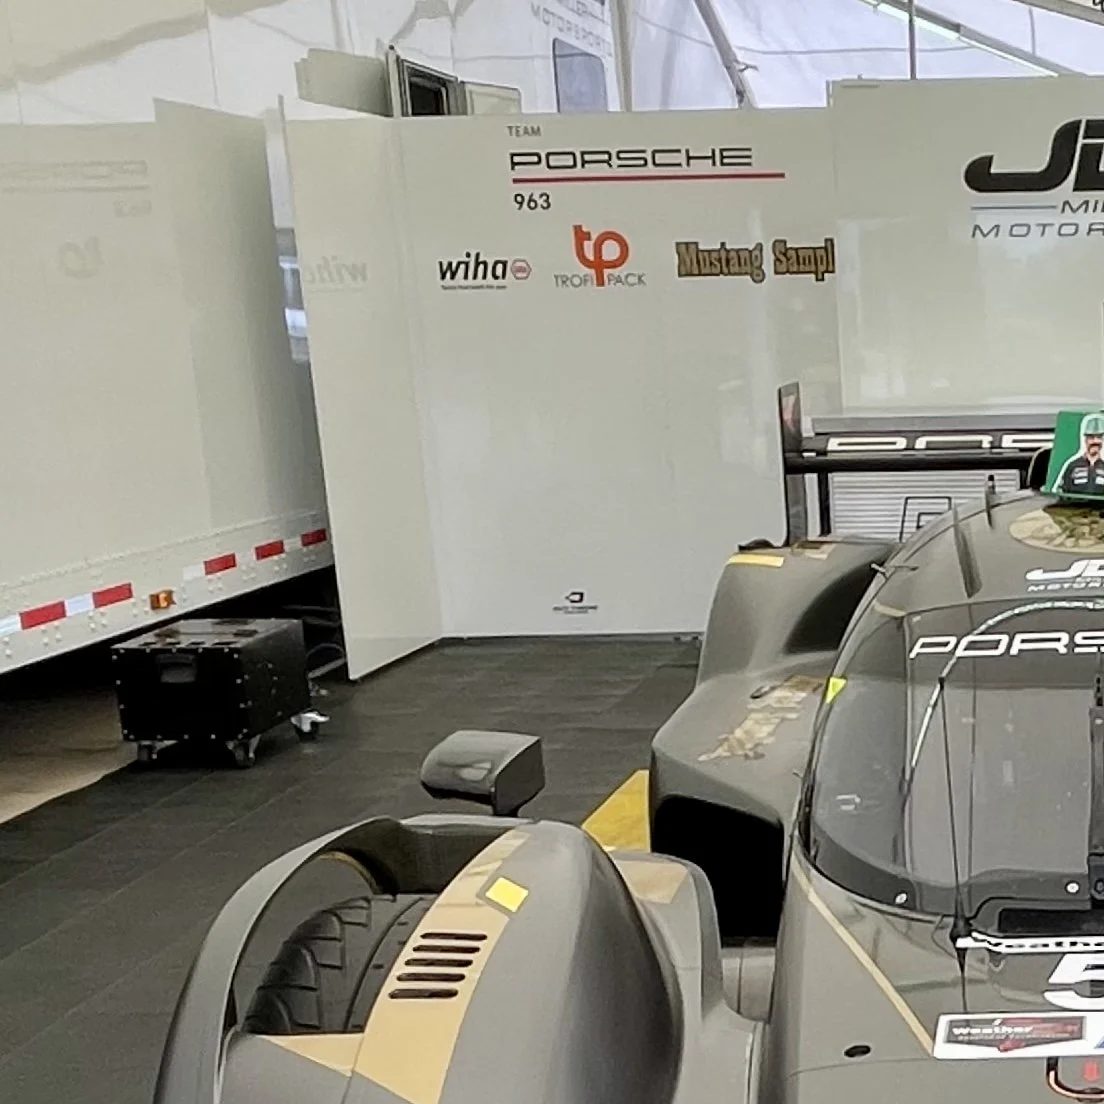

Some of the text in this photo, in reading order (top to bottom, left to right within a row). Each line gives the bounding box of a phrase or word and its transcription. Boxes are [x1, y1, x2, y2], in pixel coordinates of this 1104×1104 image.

[507, 125, 541, 137] TEAM
[510, 147, 753, 171] PORSCHE
[513, 192, 551, 211] 963
[438, 251, 508, 280] wiha
[676, 238, 835, 283] Mustang Sampl
[607, 272, 648, 288] PACK
